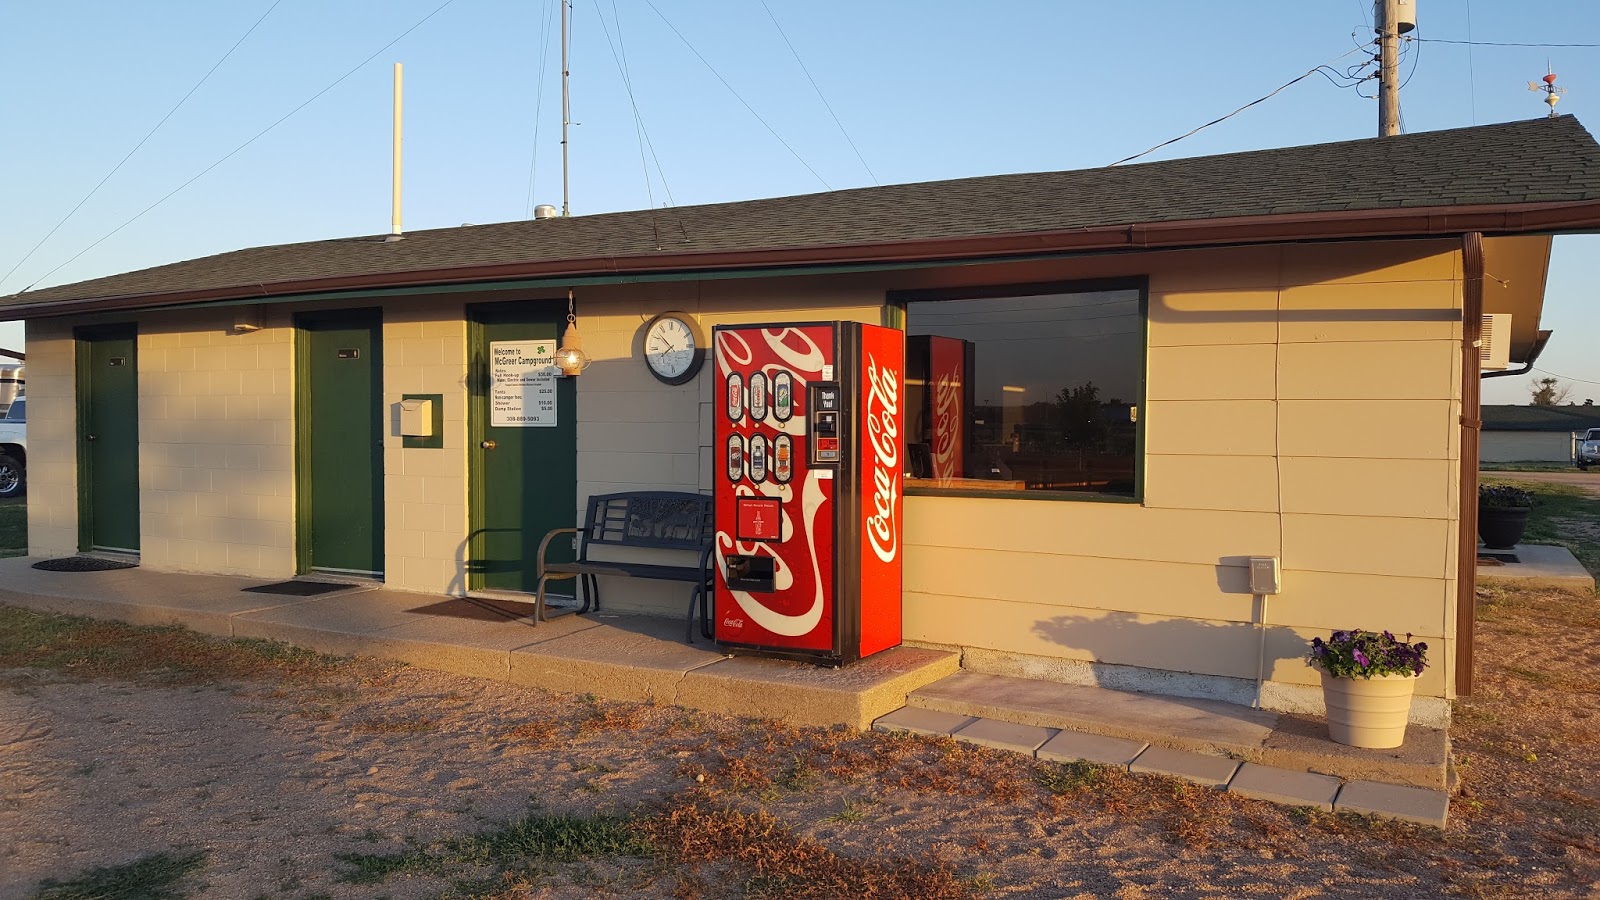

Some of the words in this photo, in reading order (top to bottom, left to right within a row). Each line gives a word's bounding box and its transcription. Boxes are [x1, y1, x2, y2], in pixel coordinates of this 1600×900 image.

[494, 348, 515, 356] Welcome
[516, 347, 521, 355] to
[494, 357, 517, 365] McGreer
[518, 355, 552, 366] Campground
[821, 391, 835, 400] Thank
[822, 400, 833, 408] You!
[867, 352, 898, 563] Coca-Cola
[723, 617, 743, 628] Coca-Cola
